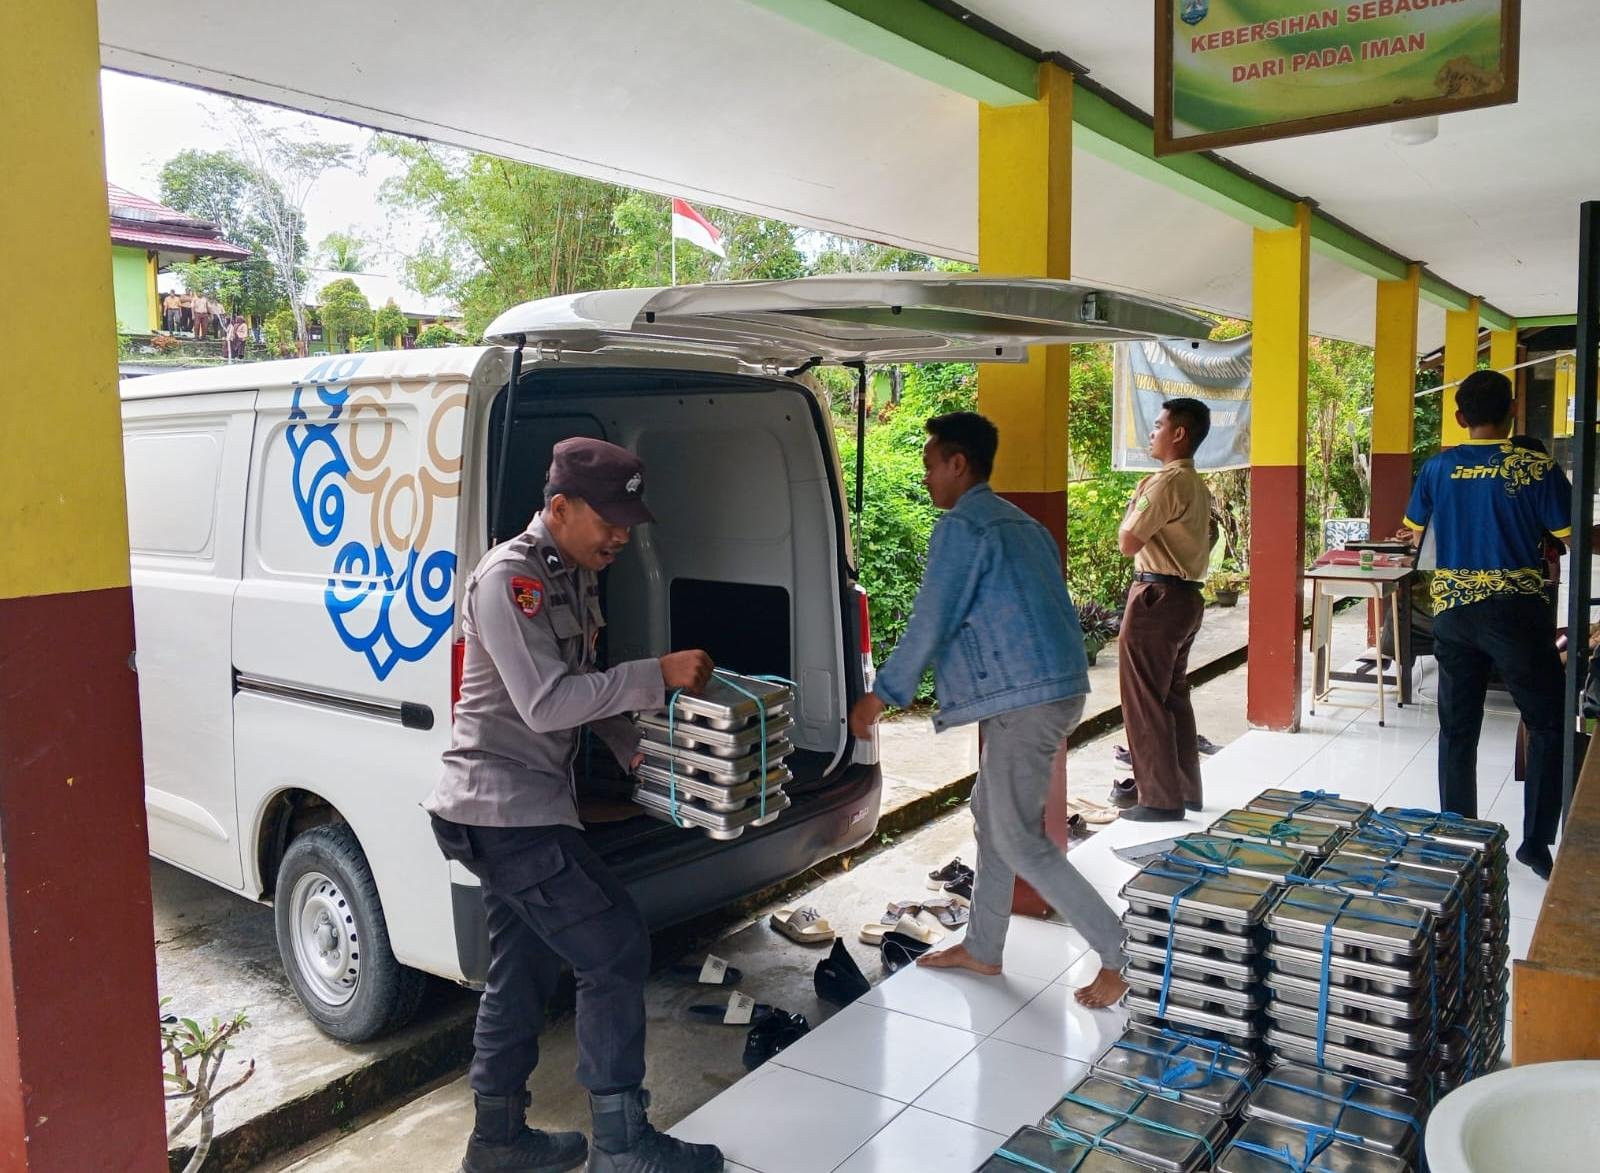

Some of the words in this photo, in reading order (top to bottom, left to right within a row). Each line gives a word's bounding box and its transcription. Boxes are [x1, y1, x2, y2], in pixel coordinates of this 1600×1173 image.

[1191, 9, 1338, 53] KEBERSIHAN
[1346, 0, 1463, 22] SEBAG
[1232, 58, 1284, 83] DARI
[1292, 46, 1353, 72] PADA
[1361, 32, 1425, 60] IMAN
